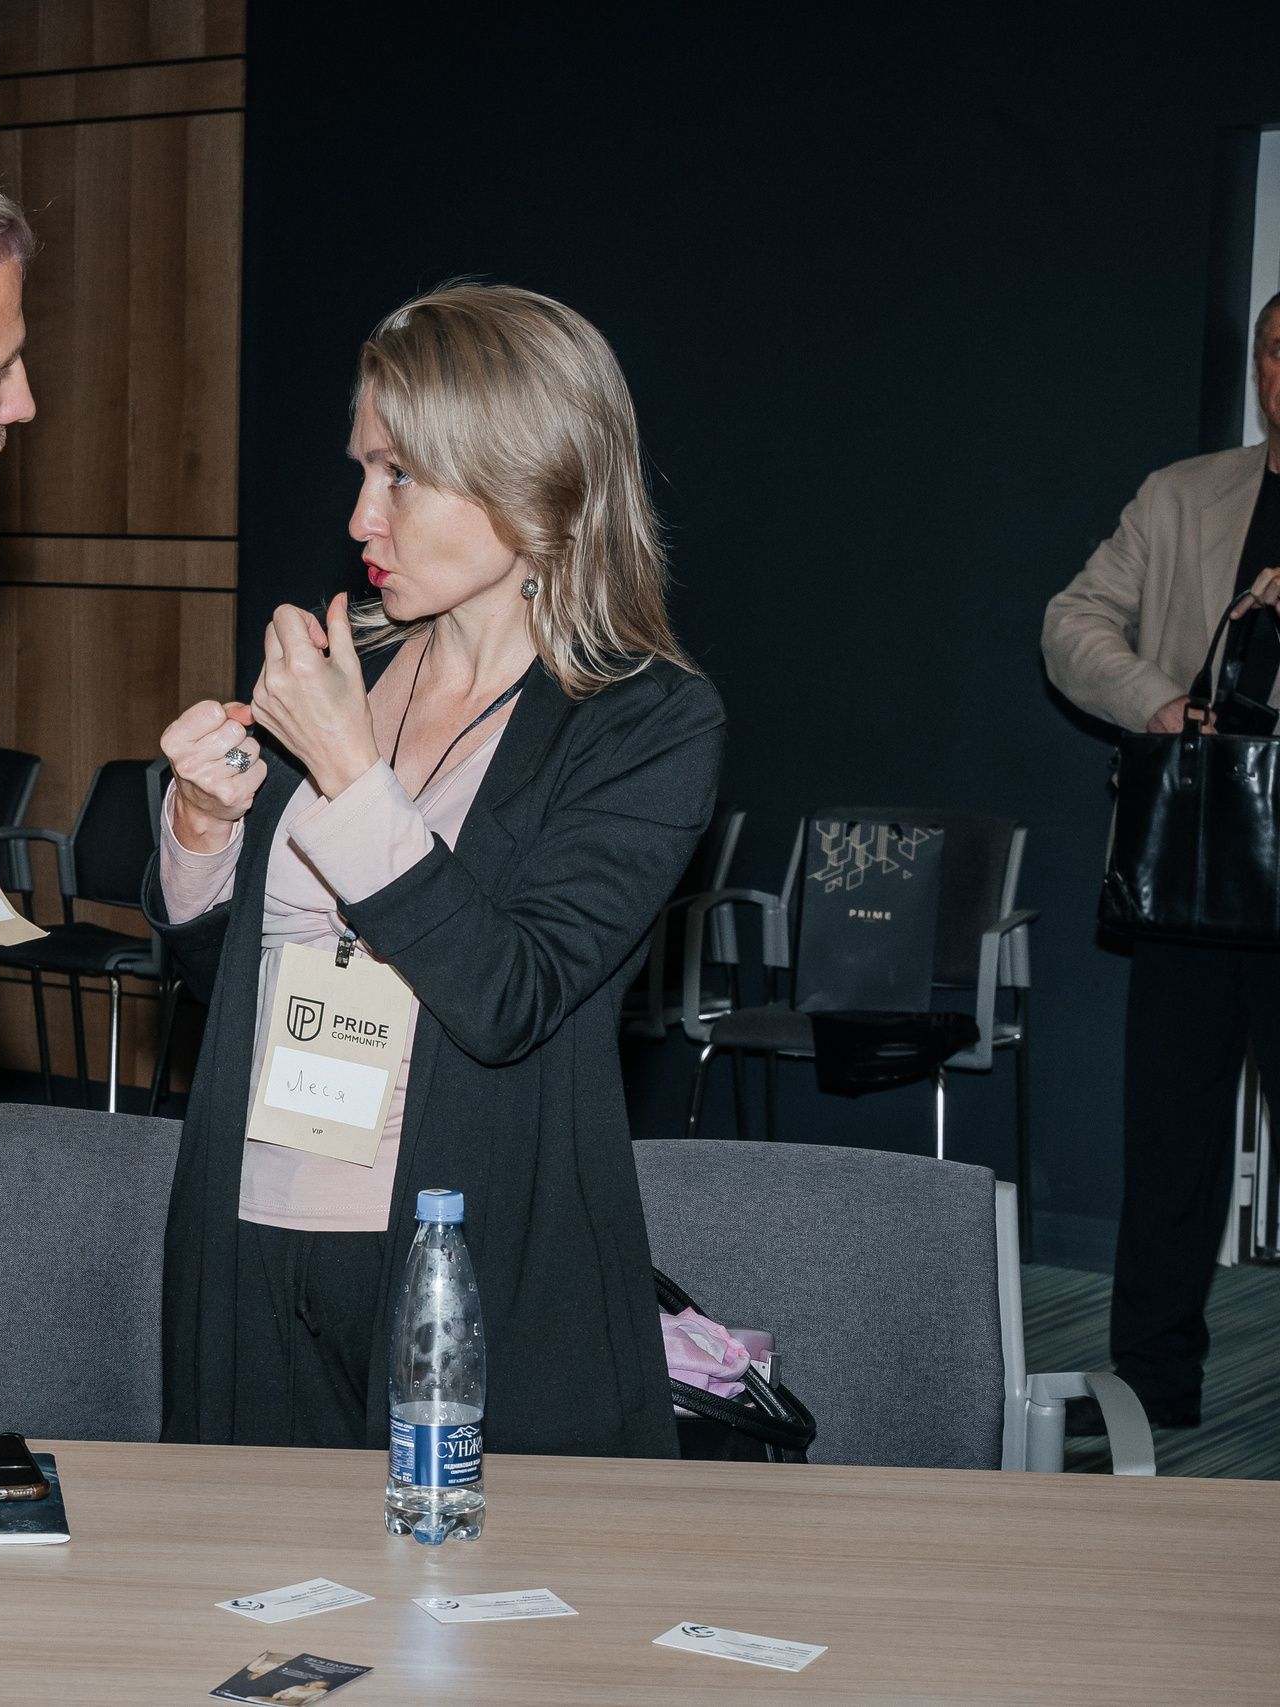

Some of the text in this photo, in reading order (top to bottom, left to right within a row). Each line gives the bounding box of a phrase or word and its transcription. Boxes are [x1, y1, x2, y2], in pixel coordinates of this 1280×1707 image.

[849, 909, 892, 921] PRIME
[332, 1014, 390, 1040] PRIDE
[331, 1031, 388, 1049] COMMUNITY
[287, 1069, 346, 1104] Леся
[311, 1127, 324, 1135] VIP
